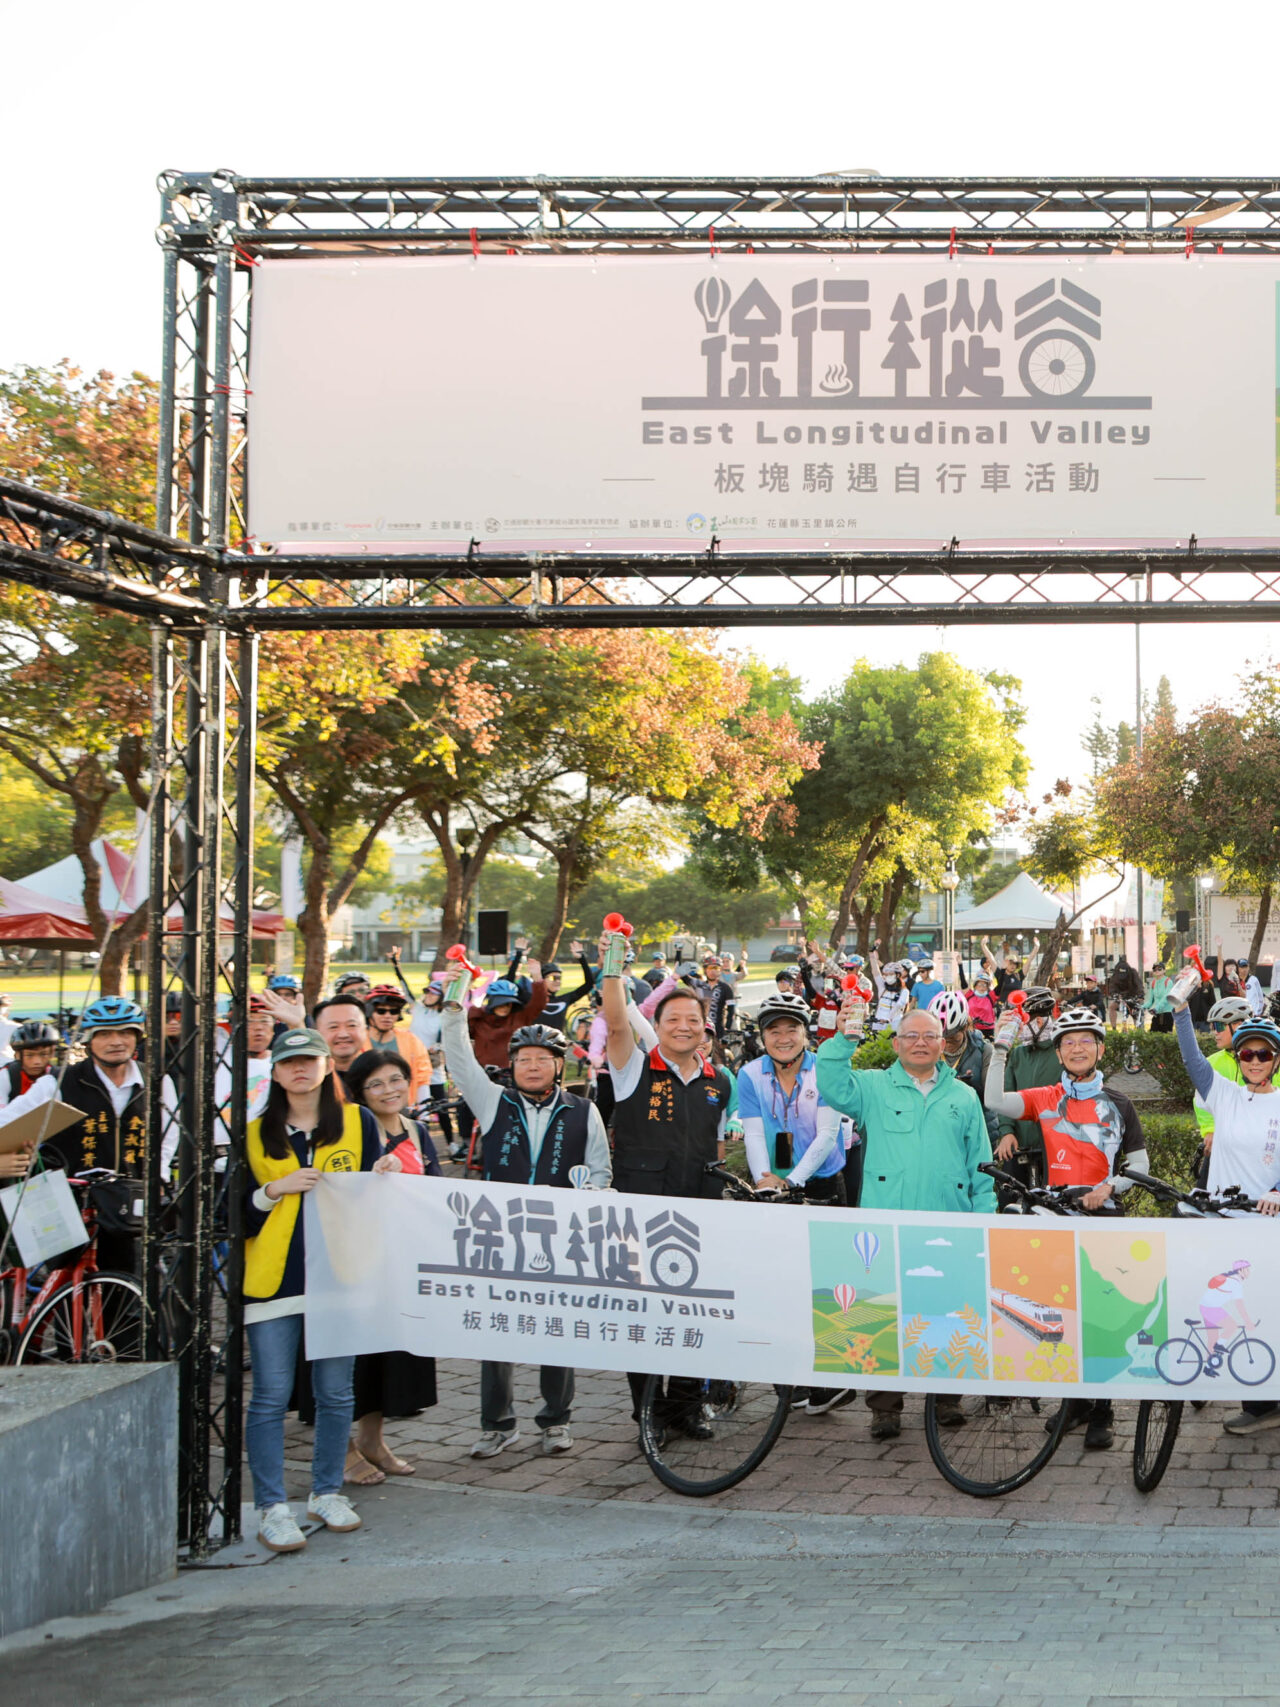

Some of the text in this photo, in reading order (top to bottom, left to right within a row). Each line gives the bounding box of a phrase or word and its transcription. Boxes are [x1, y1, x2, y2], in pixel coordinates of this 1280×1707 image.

[642, 421, 1151, 446] East Longitudinal Valley
[714, 462, 1100, 494] 板塊騎遇自行車活動
[418, 1279, 736, 1321] East Longitudinal Valley
[462, 1309, 705, 1349] 板塊騎遇自行車活動
